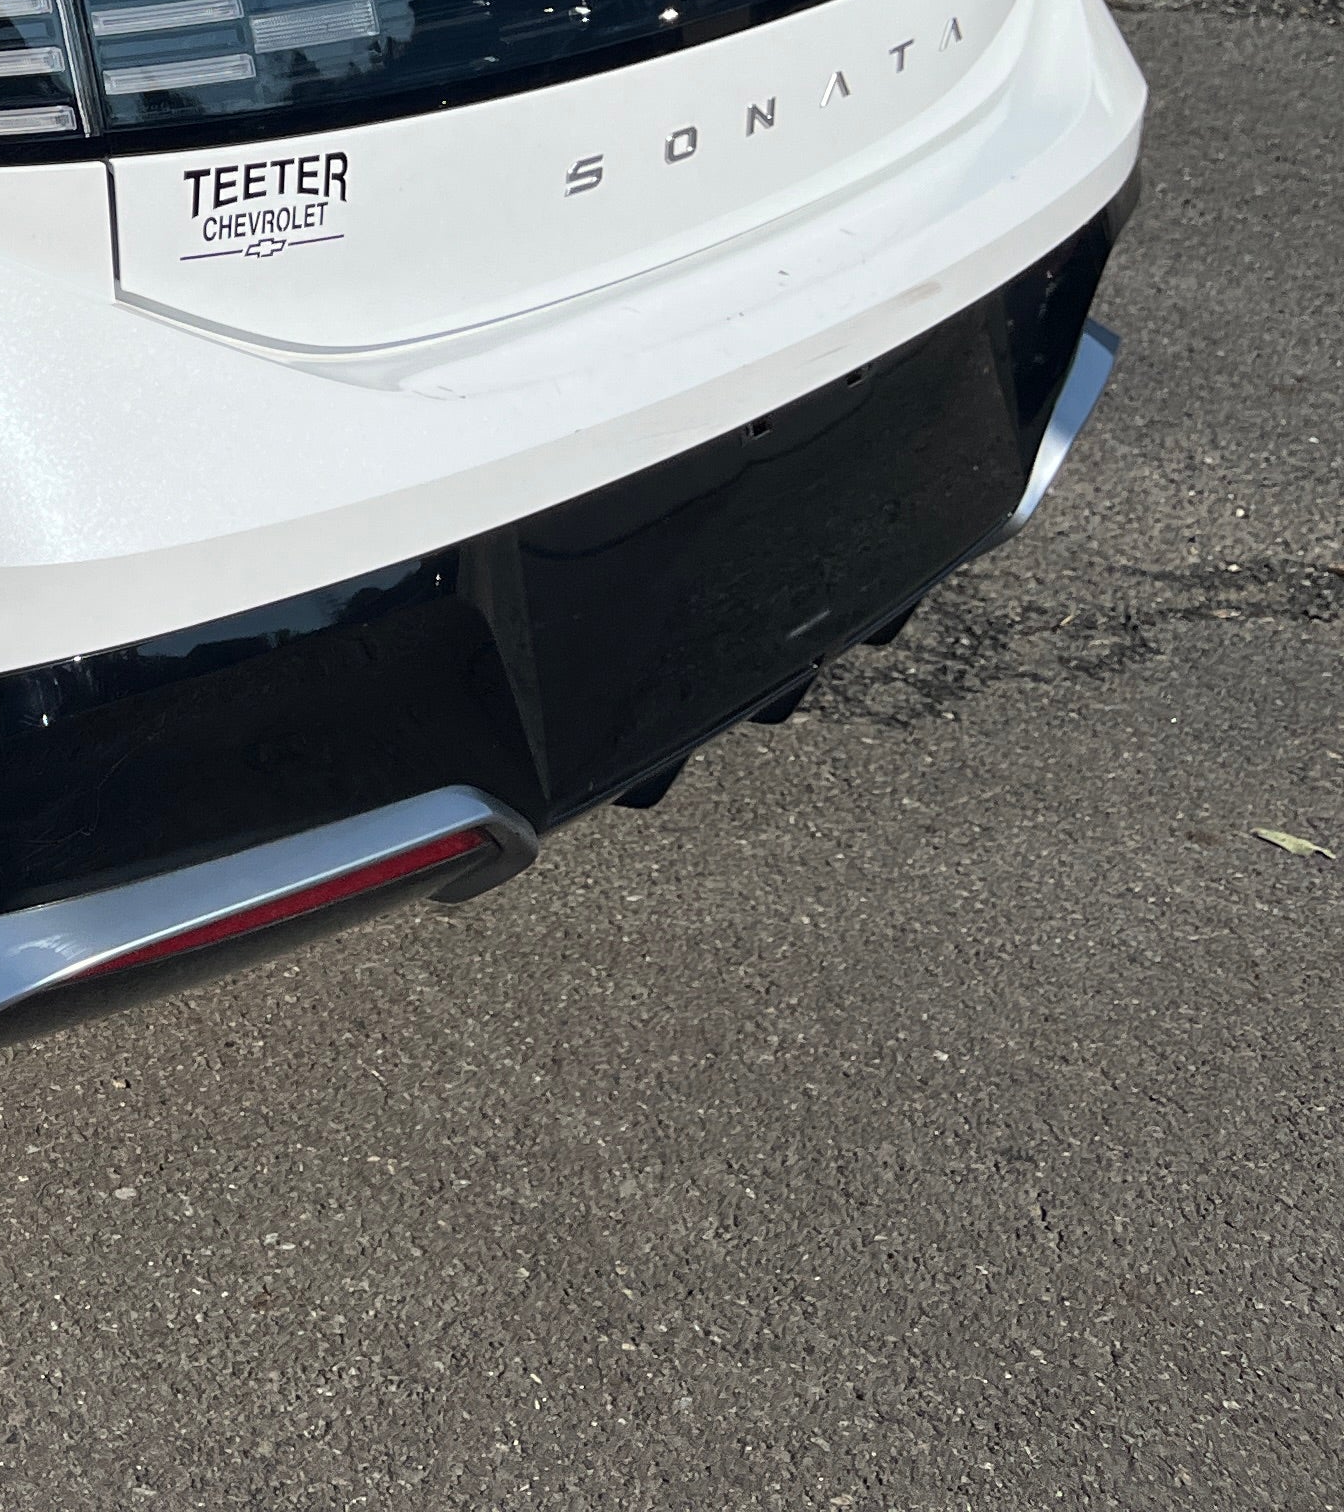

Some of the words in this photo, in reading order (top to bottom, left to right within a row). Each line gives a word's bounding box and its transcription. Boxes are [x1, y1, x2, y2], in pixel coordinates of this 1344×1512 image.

[564, 17, 963, 198] SONATA
[183, 151, 349, 219] TEETER
[202, 201, 329, 242] CHEVROLET
